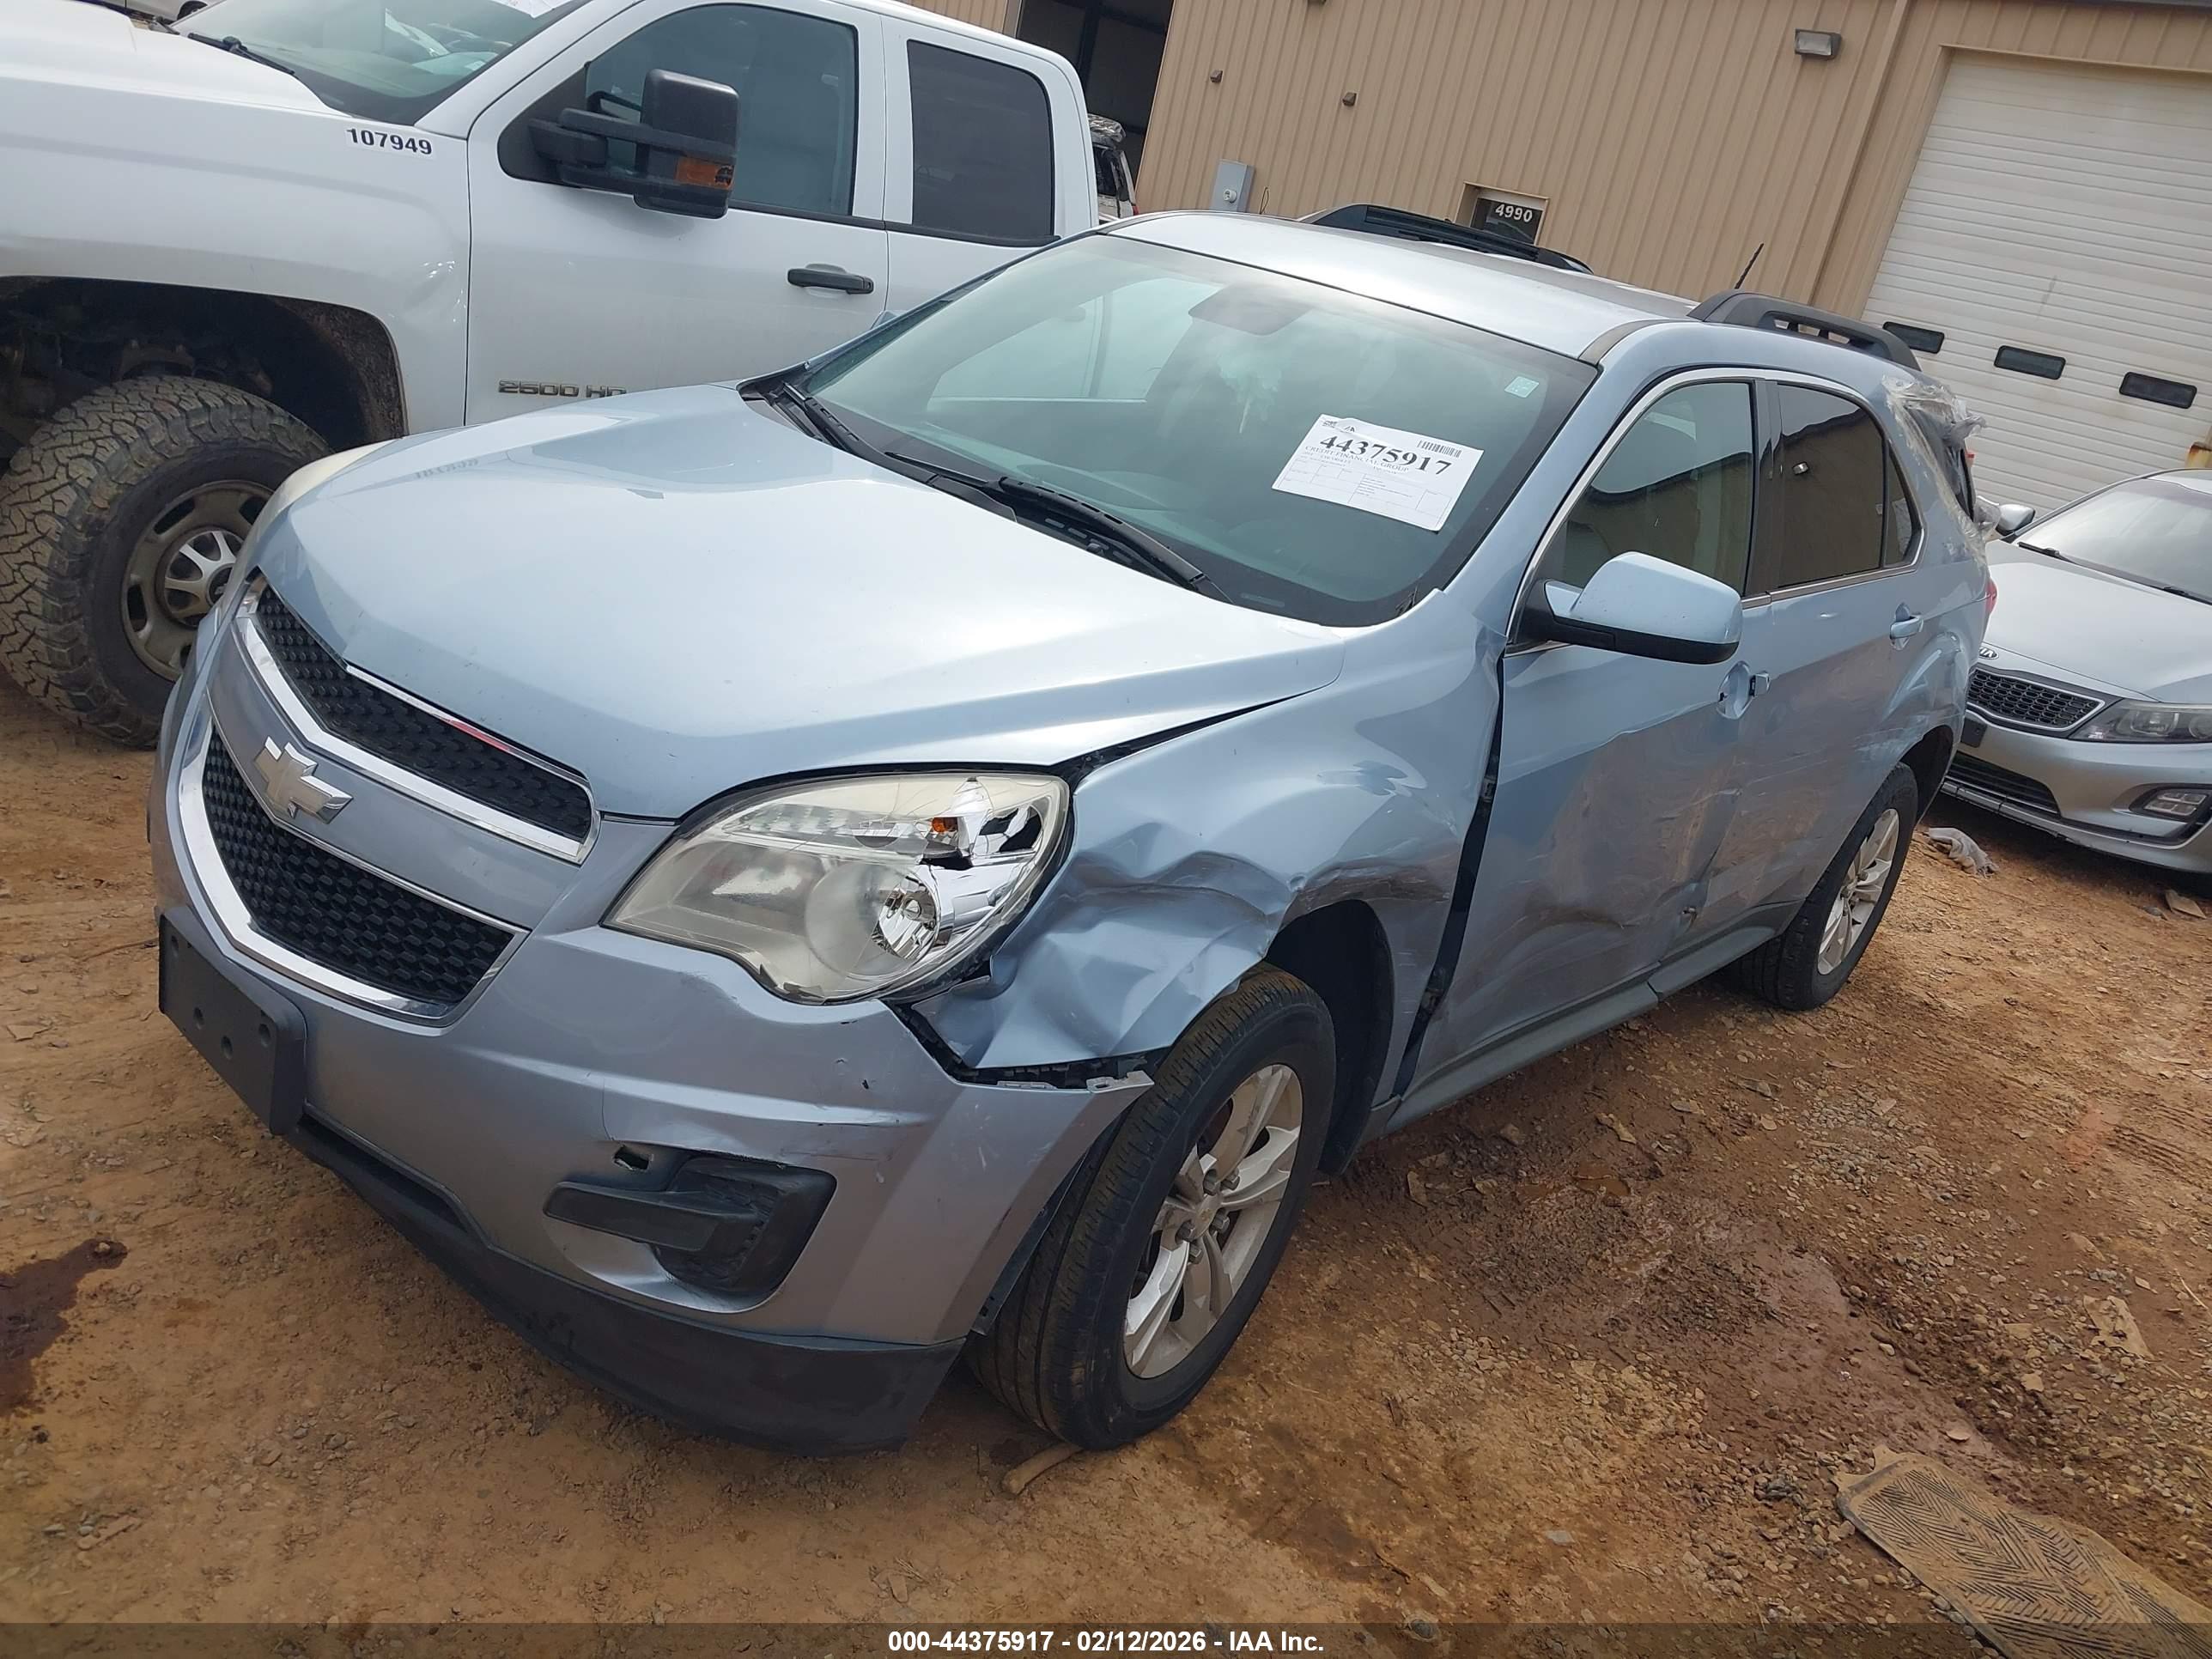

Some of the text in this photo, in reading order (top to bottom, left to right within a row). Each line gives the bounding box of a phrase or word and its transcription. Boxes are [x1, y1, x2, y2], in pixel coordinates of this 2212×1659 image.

[346, 128, 432, 155] 107949
[1495, 204, 1533, 222] 4990
[499, 380, 579, 397] 2500
[1320, 435, 1452, 475] 44375917
[1380, 462, 1409, 472] GROUP
